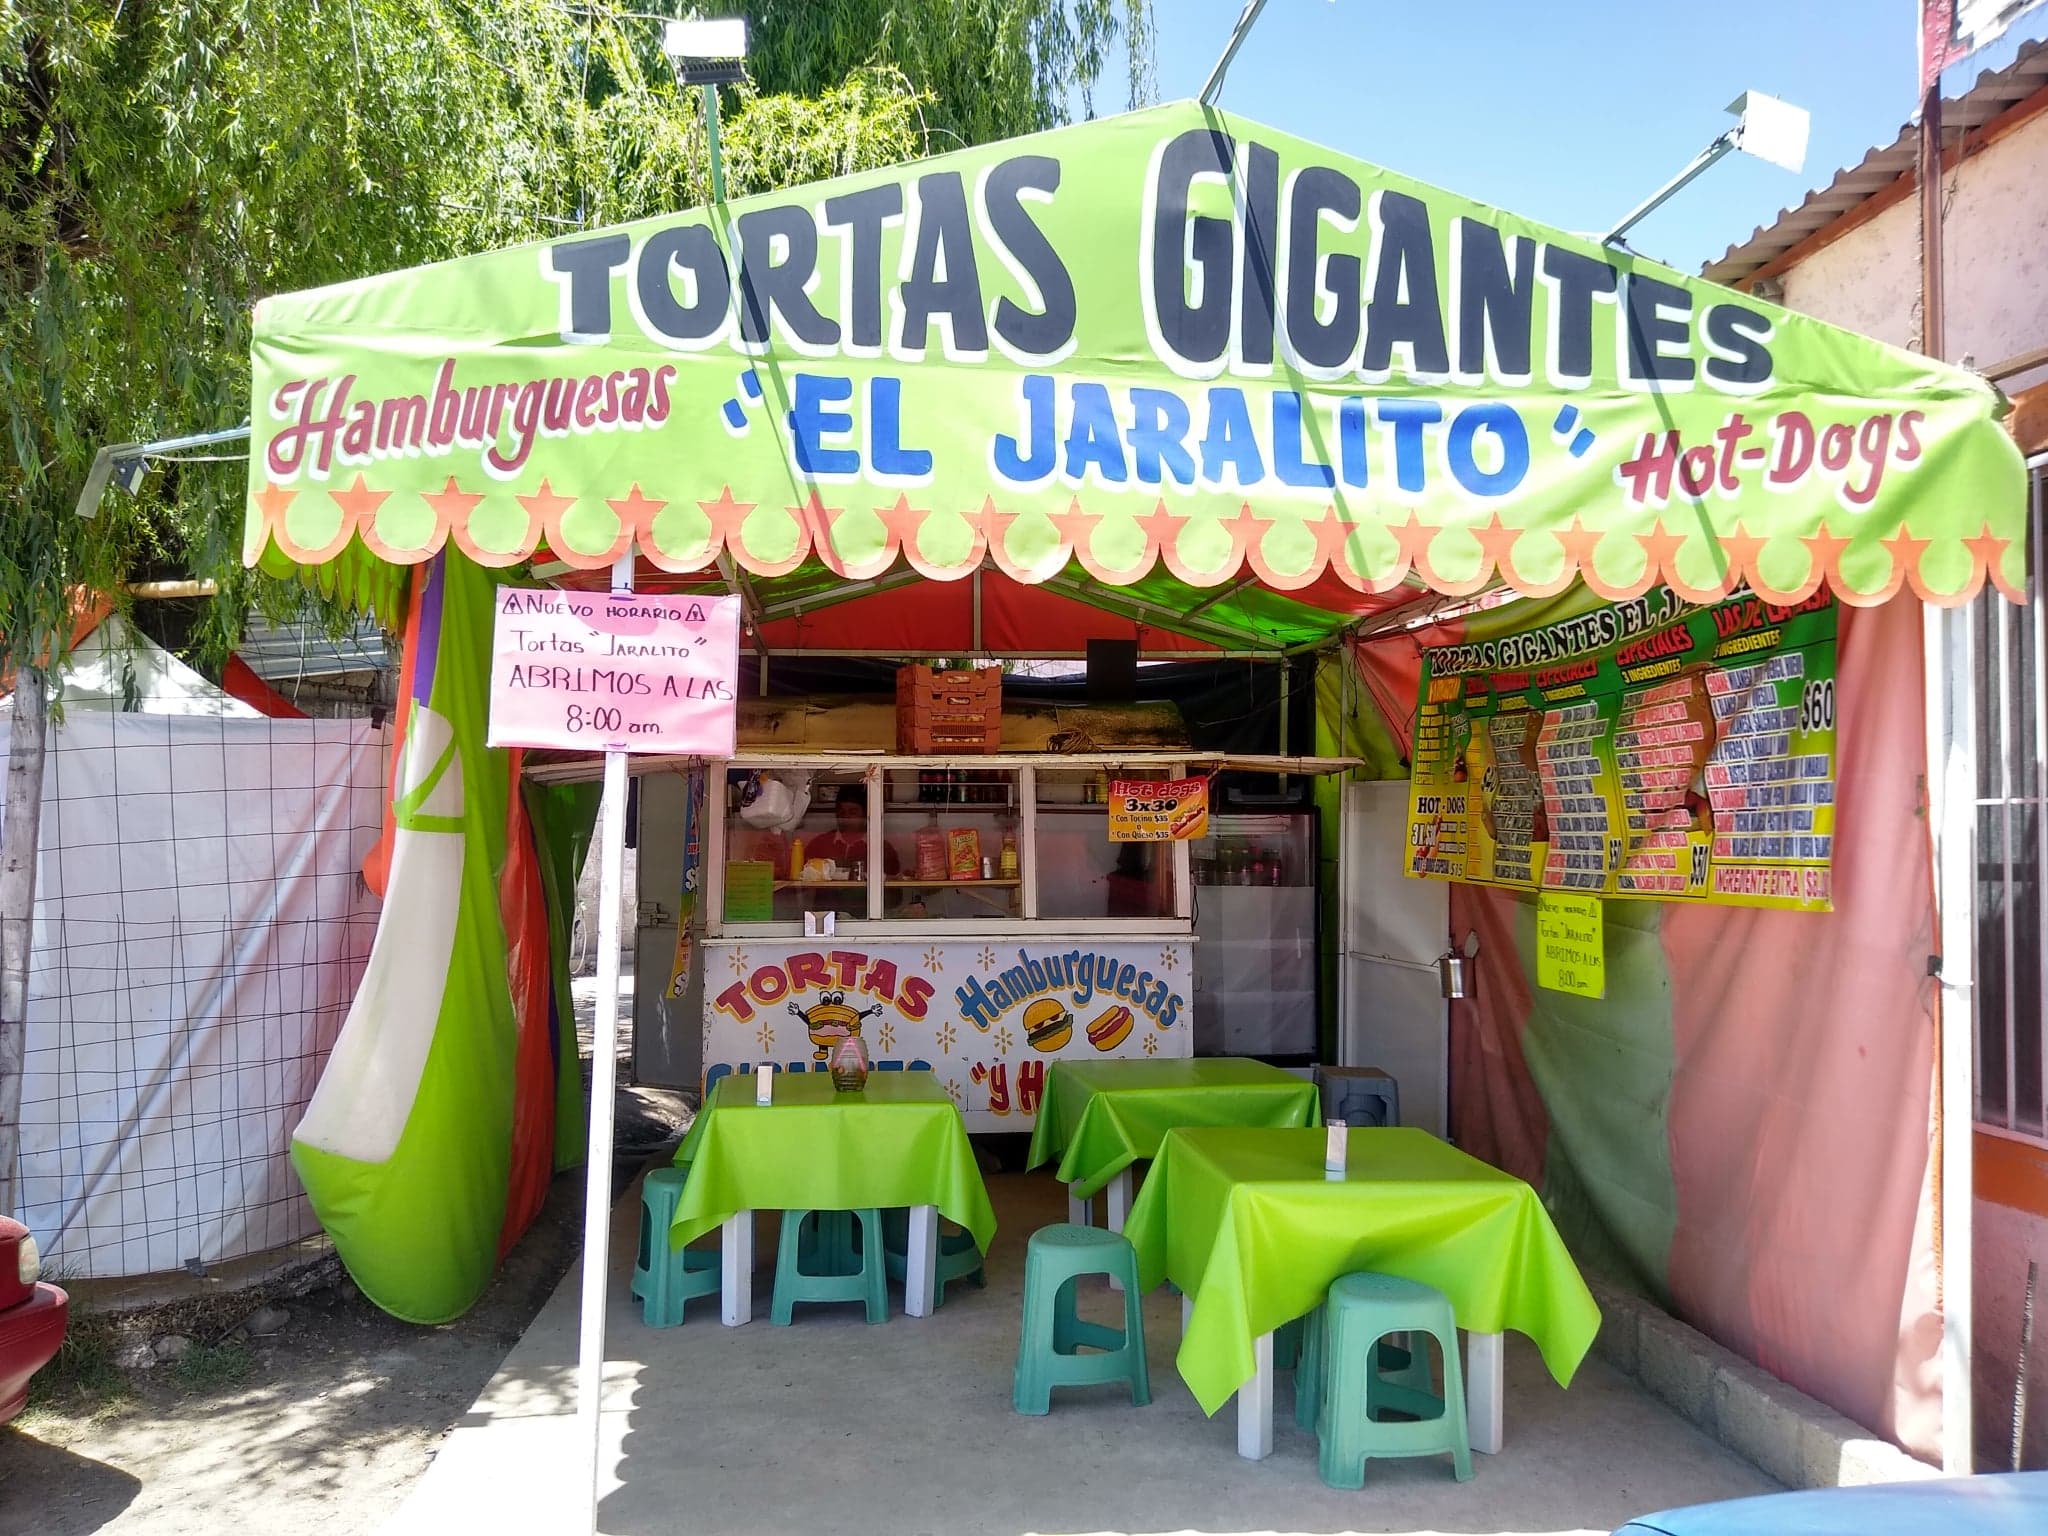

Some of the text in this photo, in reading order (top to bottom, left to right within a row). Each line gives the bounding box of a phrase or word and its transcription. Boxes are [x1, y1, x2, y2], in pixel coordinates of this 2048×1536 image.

[546, 128, 1776, 390] TORTAS GIGANTES
[266, 358, 678, 480] Hamburguesas
[1620, 408, 1926, 510] Hot-Dogs
[606, 607, 682, 622] HORARIO
[510, 629, 585, 654] Tortas
[1429, 643, 1497, 677] TORTAS
[1497, 611, 1617, 670] GIGANTES
[1614, 596, 1657, 641] EL
[1615, 623, 1694, 667] ESPECIALES
[1718, 629, 1780, 656] INGREDIENTES
[508, 664, 734, 701] ABRIMOS A LAS
[1622, 658, 1681, 684] 3 INGREDIENTES
[566, 704, 622, 733] 8:00
[1801, 679, 1834, 738] $60
[1158, 781, 1202, 798] dogs
[1125, 797, 1179, 813] 3x30
[1153, 814, 1169, 824] $35
[1116, 830, 1170, 840] Con Queso $35
[1545, 944, 1581, 964] ABRIMOS
[714, 946, 1186, 1032] TORTAS Hamburguesas
